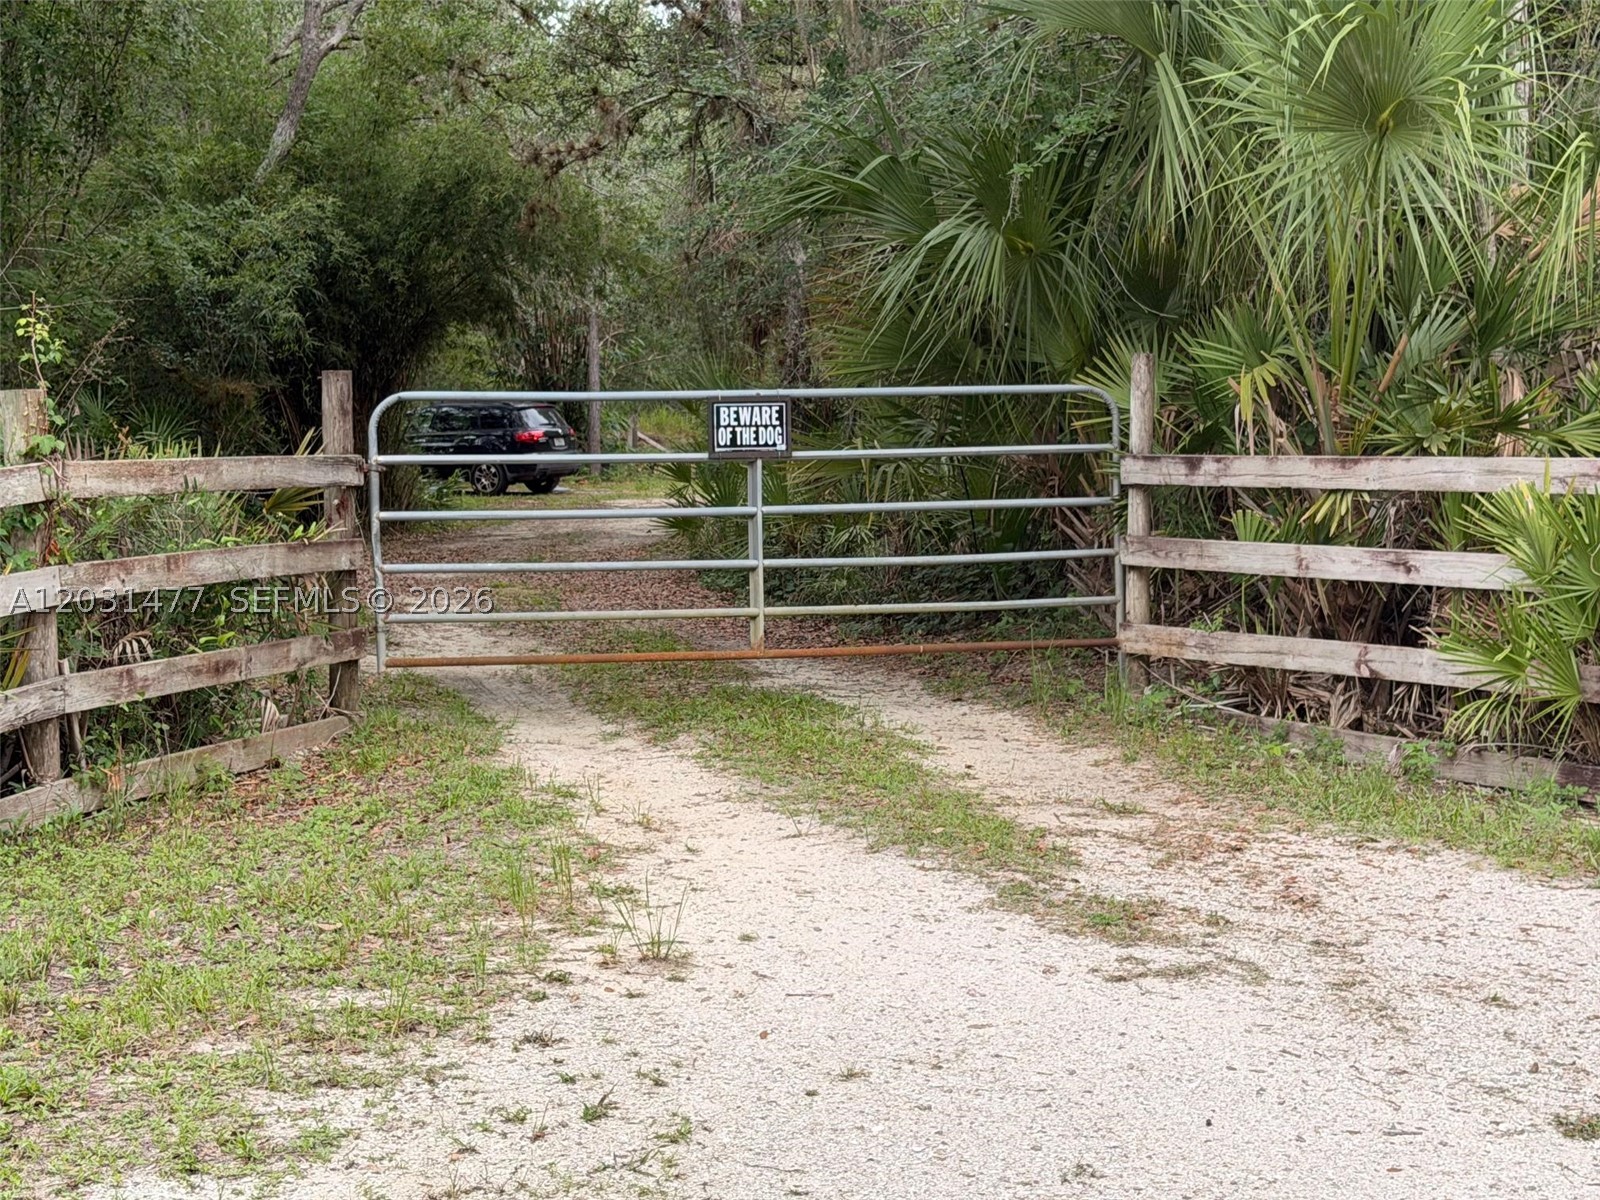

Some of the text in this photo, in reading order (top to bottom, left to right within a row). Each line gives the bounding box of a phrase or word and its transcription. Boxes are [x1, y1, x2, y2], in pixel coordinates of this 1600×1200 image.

[720, 406, 780, 426] BEWARE
[718, 426, 783, 446] OF THE DOG
